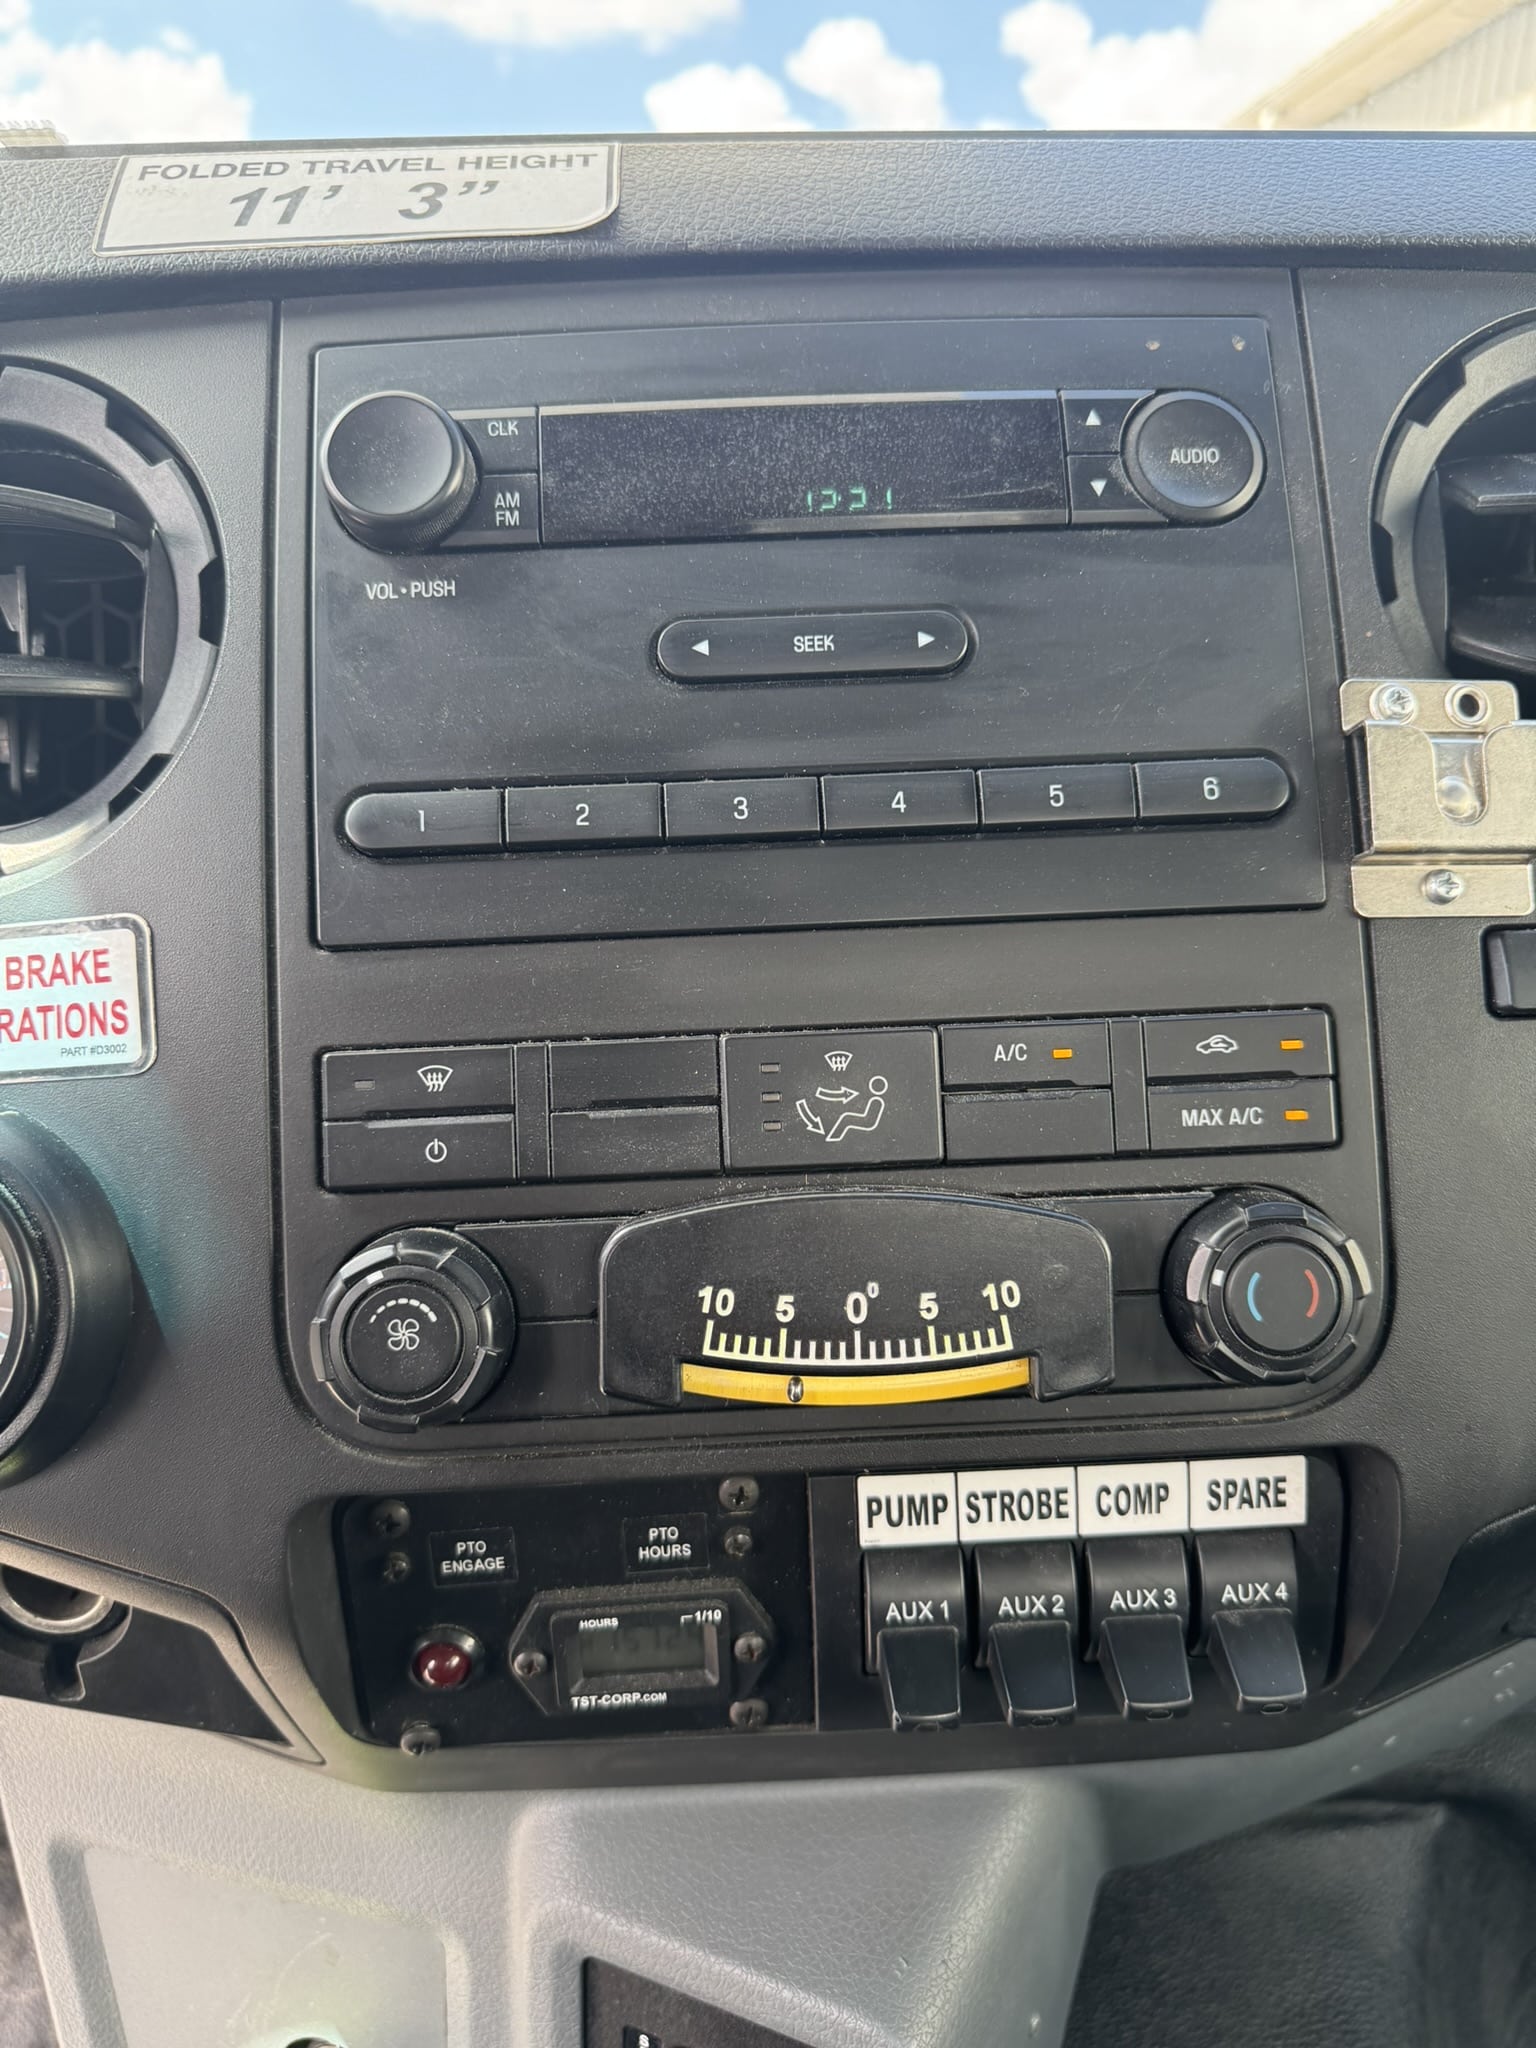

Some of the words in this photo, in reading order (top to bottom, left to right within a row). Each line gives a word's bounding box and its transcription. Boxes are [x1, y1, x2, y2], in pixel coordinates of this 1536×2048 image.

[138, 161, 290, 181] FOLDED
[302, 157, 446, 175] TRAVEL
[457, 153, 598, 171] HEIGHT
[487, 420, 519, 437] CLK
[1170, 447, 1220, 465] AUDIO
[494, 491, 520, 508] AM
[495, 510, 520, 526] FM
[793, 634, 835, 653] SEEK
[1049, 784, 1065, 807] 5
[1203, 777, 1220, 801] 6
[733, 796, 749, 820] 3
[891, 790, 907, 813] 4
[418, 809, 425, 832] 1
[575, 803, 590, 826] 2
[5, 948, 113, 991] BRAKE
[60, 1046, 88, 1058] PART
[90, 1043, 128, 1056] #D3002
[994, 1043, 1028, 1062] A/C
[1181, 1108, 1223, 1127] MAX
[1228, 1106, 1263, 1125] A/C
[698, 1285, 735, 1317] 10
[775, 1294, 795, 1323] 5
[919, 1292, 939, 1320] 5
[982, 1279, 1021, 1311] 10
[1096, 1483, 1170, 1518] COMP
[1208, 1476, 1287, 1512] SPARE
[866, 1493, 949, 1529] PUMP
[966, 1487, 1070, 1524] STROBE
[649, 1526, 679, 1541] PTO
[456, 1540, 487, 1555] PTO
[639, 1543, 692, 1560] HOURS
[442, 1556, 505, 1573] ENGAGE
[1110, 1588, 1159, 1609] AUX
[1163, 1587, 1177, 1607] 3
[1221, 1582, 1270, 1603] AUX
[1275, 1581, 1288, 1600] 4
[886, 1600, 934, 1621] AUX
[940, 1599, 949, 1619] 1
[998, 1595, 1047, 1615] AUX
[1051, 1594, 1064, 1614] 2
[579, 1617, 619, 1629] HOURS
[694, 1609, 722, 1622] 1/10
